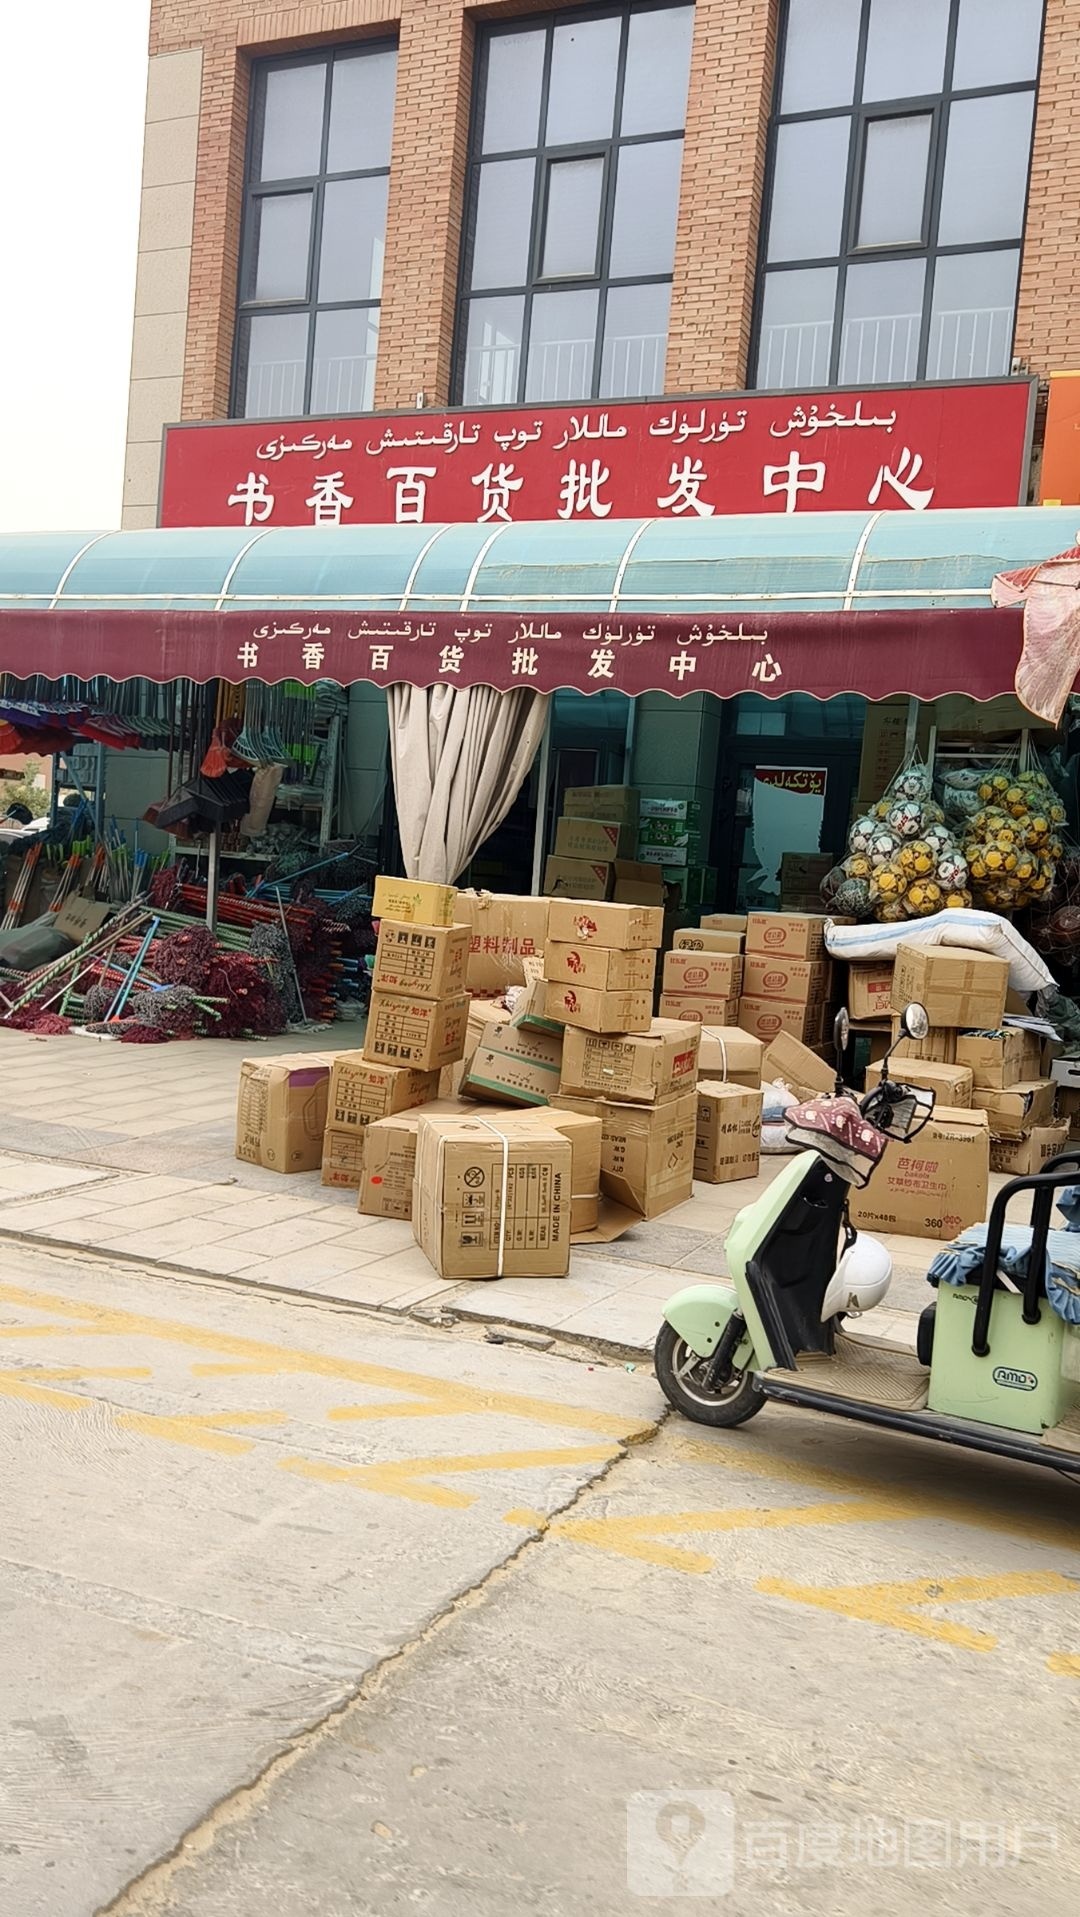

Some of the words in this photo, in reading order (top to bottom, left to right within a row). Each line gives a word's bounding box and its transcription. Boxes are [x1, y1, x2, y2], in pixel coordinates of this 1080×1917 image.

[552, 413, 628, 450] ماللار
[648, 408, 748, 443] تۈرلۈك
[770, 400, 897, 438] بىلخۇش
[256, 433, 353, 460] مەركىزى
[365, 420, 481, 456] تارقىتىش
[493, 420, 543, 451] توپ
[227, 446, 935, 527] 书香百货批发中心
[253, 620, 331, 640] مەركىزى
[347, 620, 436, 641] تارقىتىش
[454, 622, 492, 644] توپ
[508, 622, 562, 643] ماللار
[582, 622, 656, 647] تۈرلۈك
[676, 622, 769, 647] بىلخۇش
[237, 641, 783, 683] 书香百货批发中心
[553, 1172, 562, 1201] CHINA
[552, 1203, 561, 1213] IN
[551, 1215, 560, 1242] MADE
[924, 1217, 943, 1229] 360
